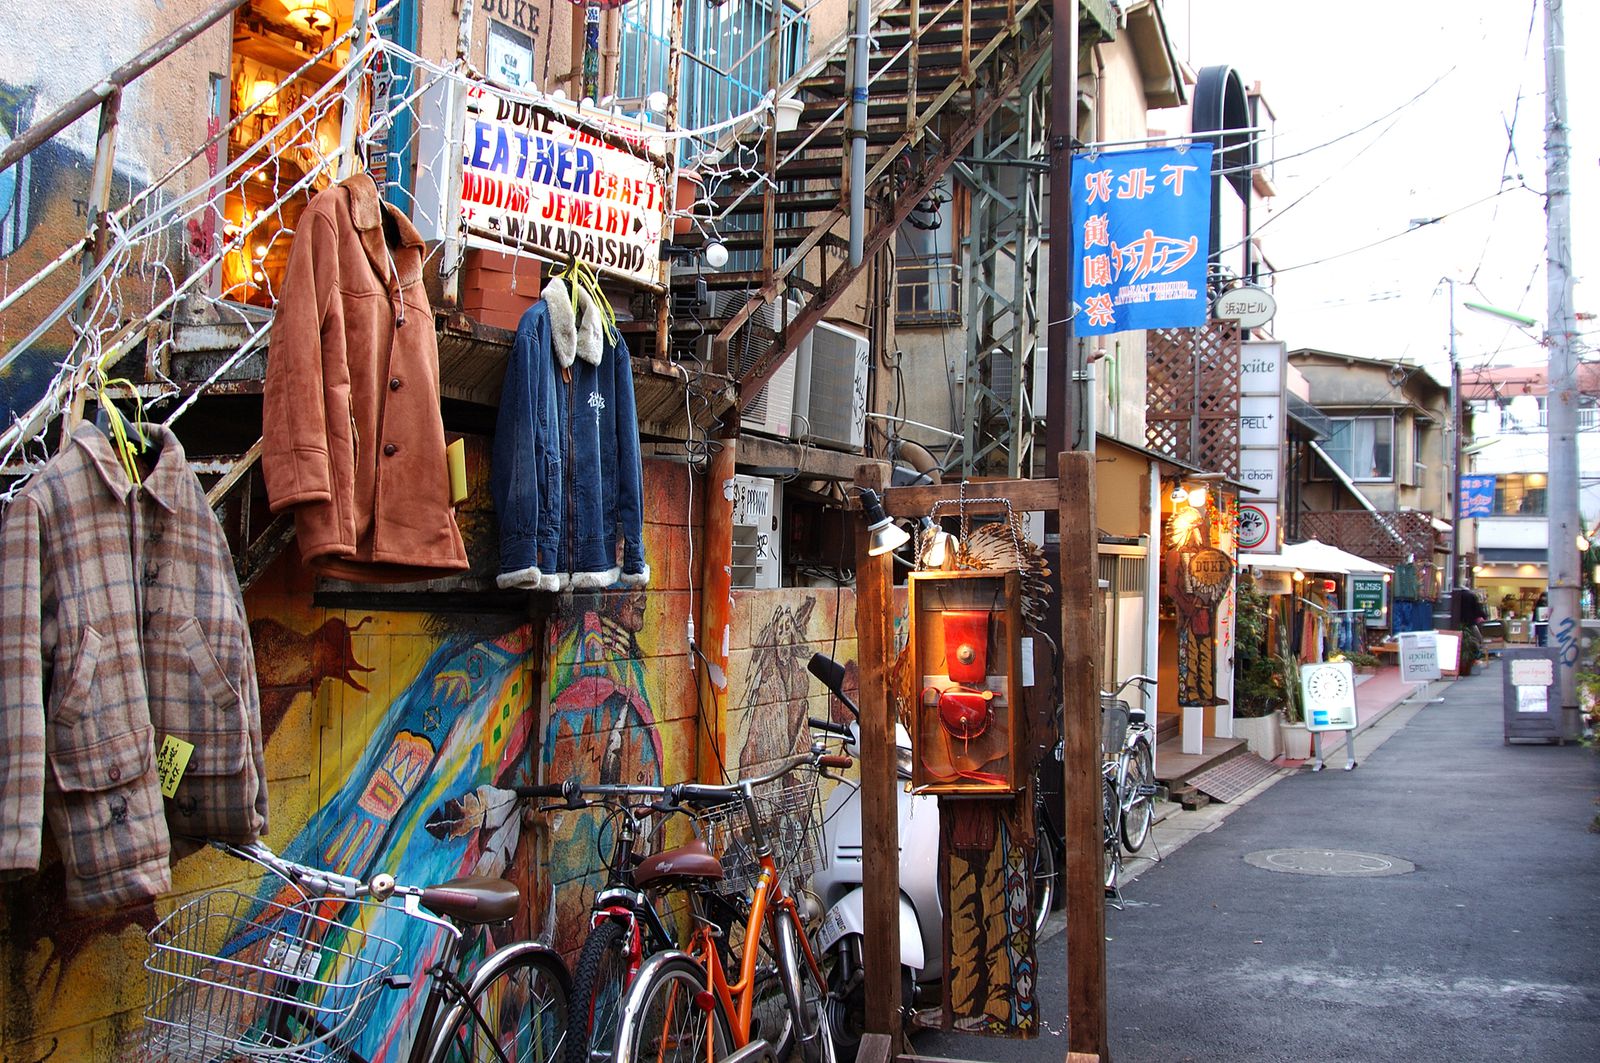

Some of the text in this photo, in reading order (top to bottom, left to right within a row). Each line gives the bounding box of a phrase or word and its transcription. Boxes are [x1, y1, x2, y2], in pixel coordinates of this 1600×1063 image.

[463, 120, 594, 196] EATHER
[462, 171, 630, 236] INDIAN JEWELRY
[1225, 302, 1267, 315] 浜辺ビル
[1196, 560, 1226, 573] DUKE
